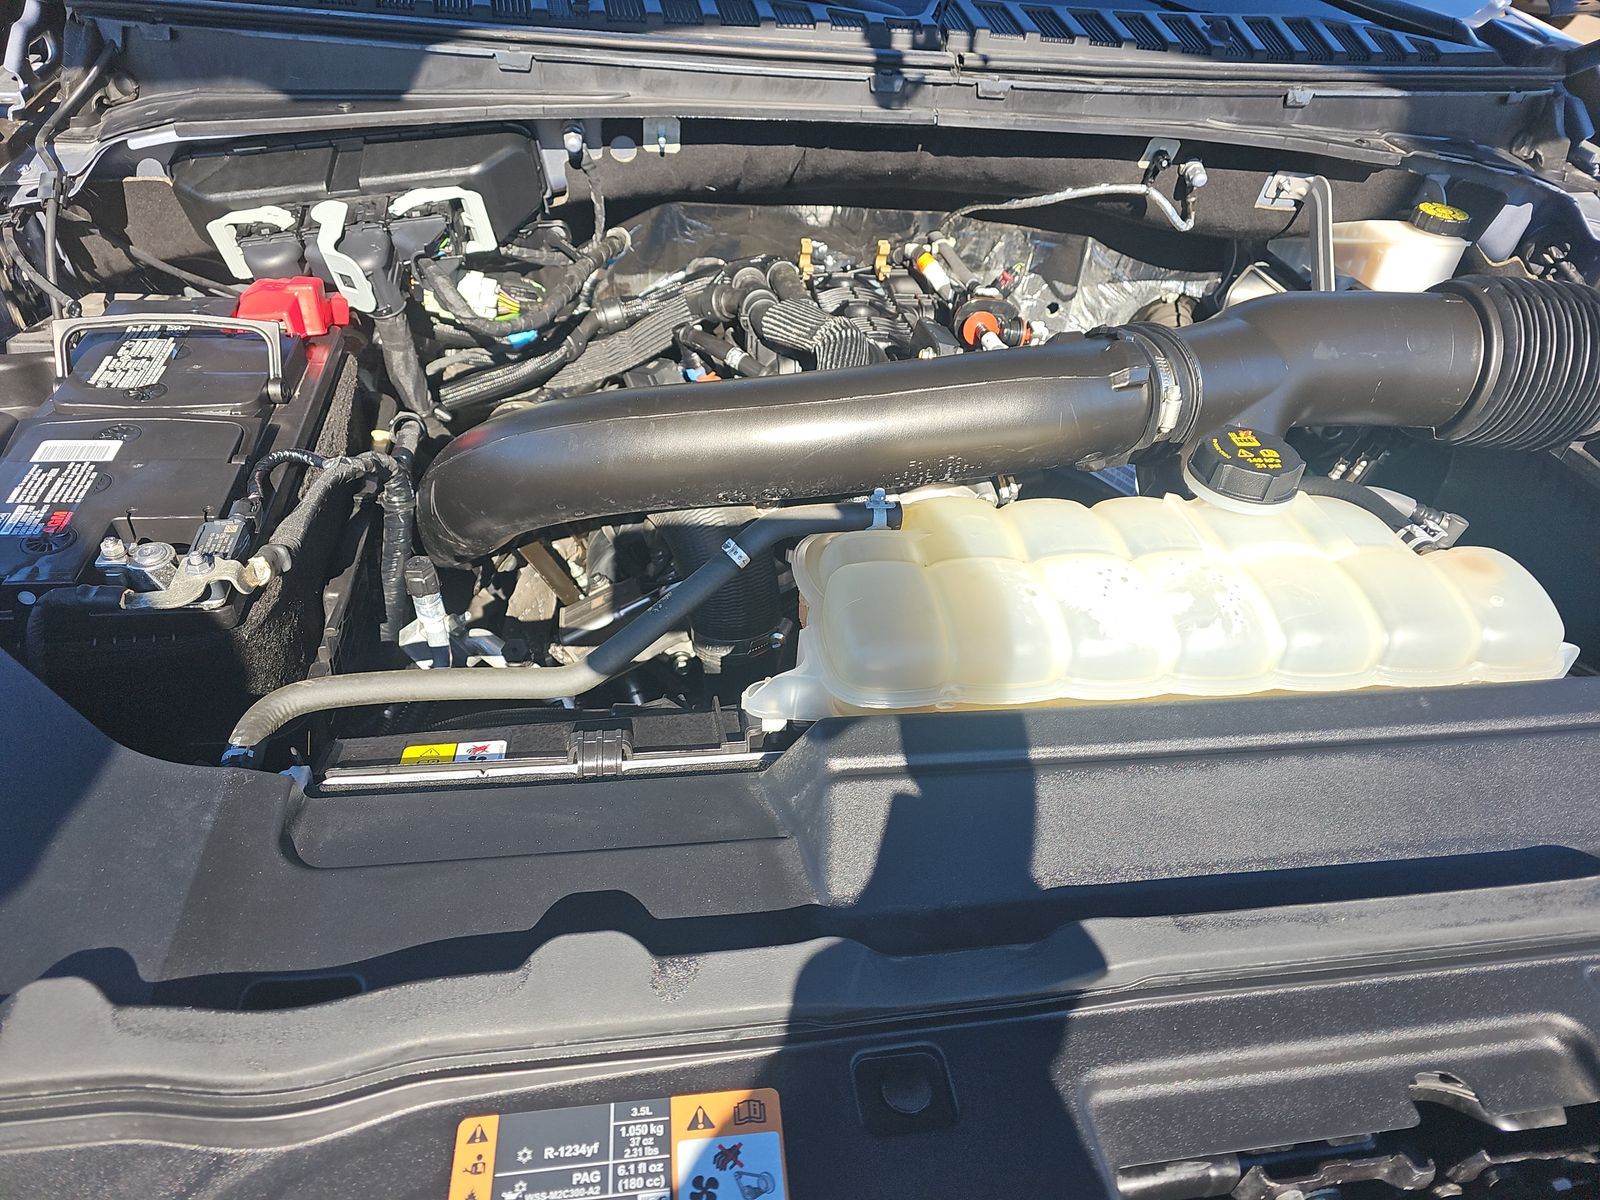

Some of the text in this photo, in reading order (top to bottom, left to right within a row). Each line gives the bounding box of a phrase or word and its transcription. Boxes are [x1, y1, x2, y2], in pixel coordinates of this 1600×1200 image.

[630, 1106, 653, 1117] 3.5L
[619, 1123, 664, 1137] 1.050 kg
[629, 1137, 655, 1147] 37 oz
[543, 1142, 600, 1159] R-1234yf
[623, 1146, 659, 1158] 2.31 lbs
[617, 1162, 664, 1176] 6.1 fl oz
[572, 1170, 601, 1185] PAG
[617, 1174, 666, 1192] (180 cc)
